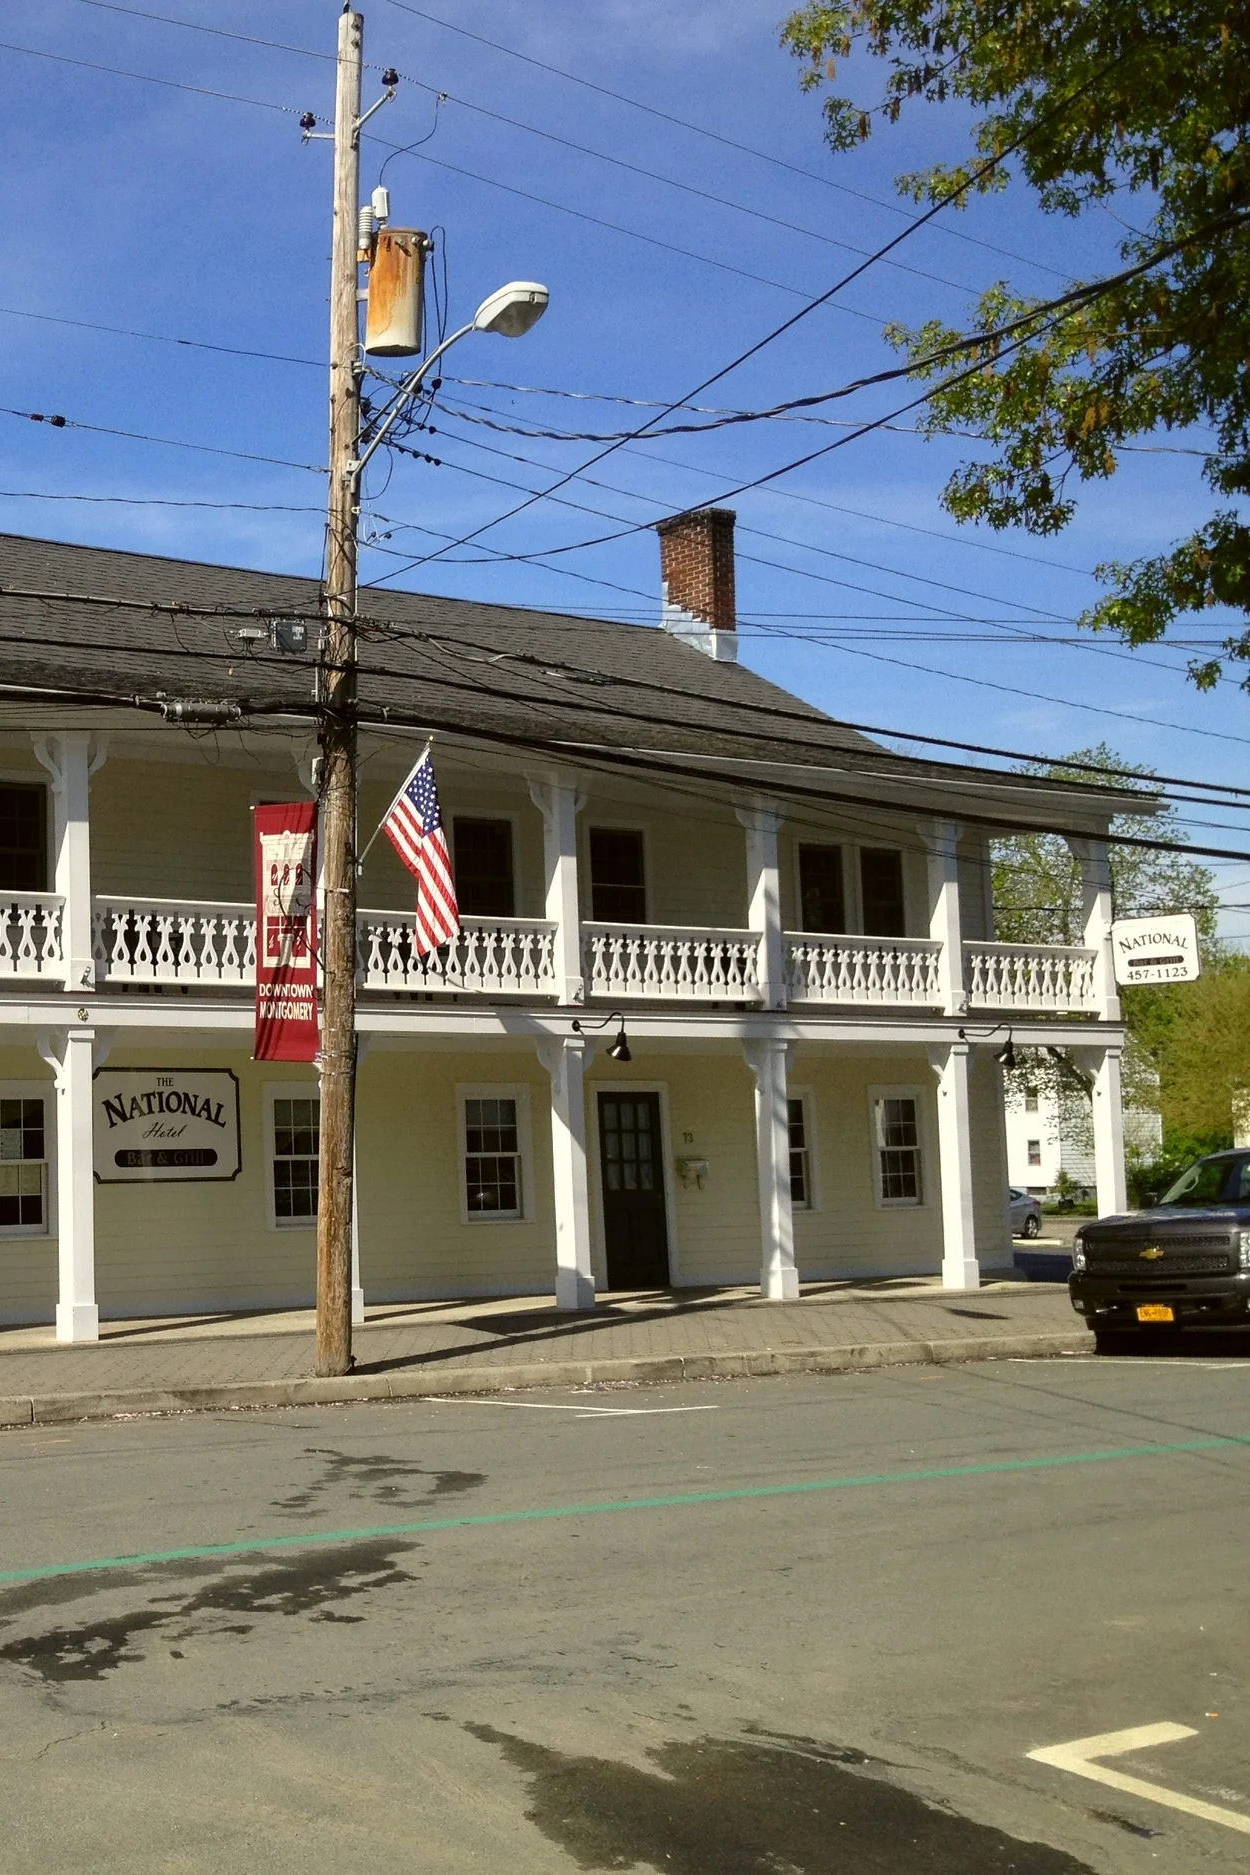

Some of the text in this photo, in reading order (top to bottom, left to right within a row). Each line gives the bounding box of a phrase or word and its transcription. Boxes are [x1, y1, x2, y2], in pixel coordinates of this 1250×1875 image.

[1118, 933, 1188, 954] NATIONAL
[1127, 967, 1188, 980] 457-1123
[259, 983, 314, 998] DOWNTOWN
[259, 1001, 314, 1020] MONTGOMERY
[156, 1077, 174, 1087] THE
[101, 1091, 227, 1129] NATIONAL
[142, 1122, 187, 1139] Hotel
